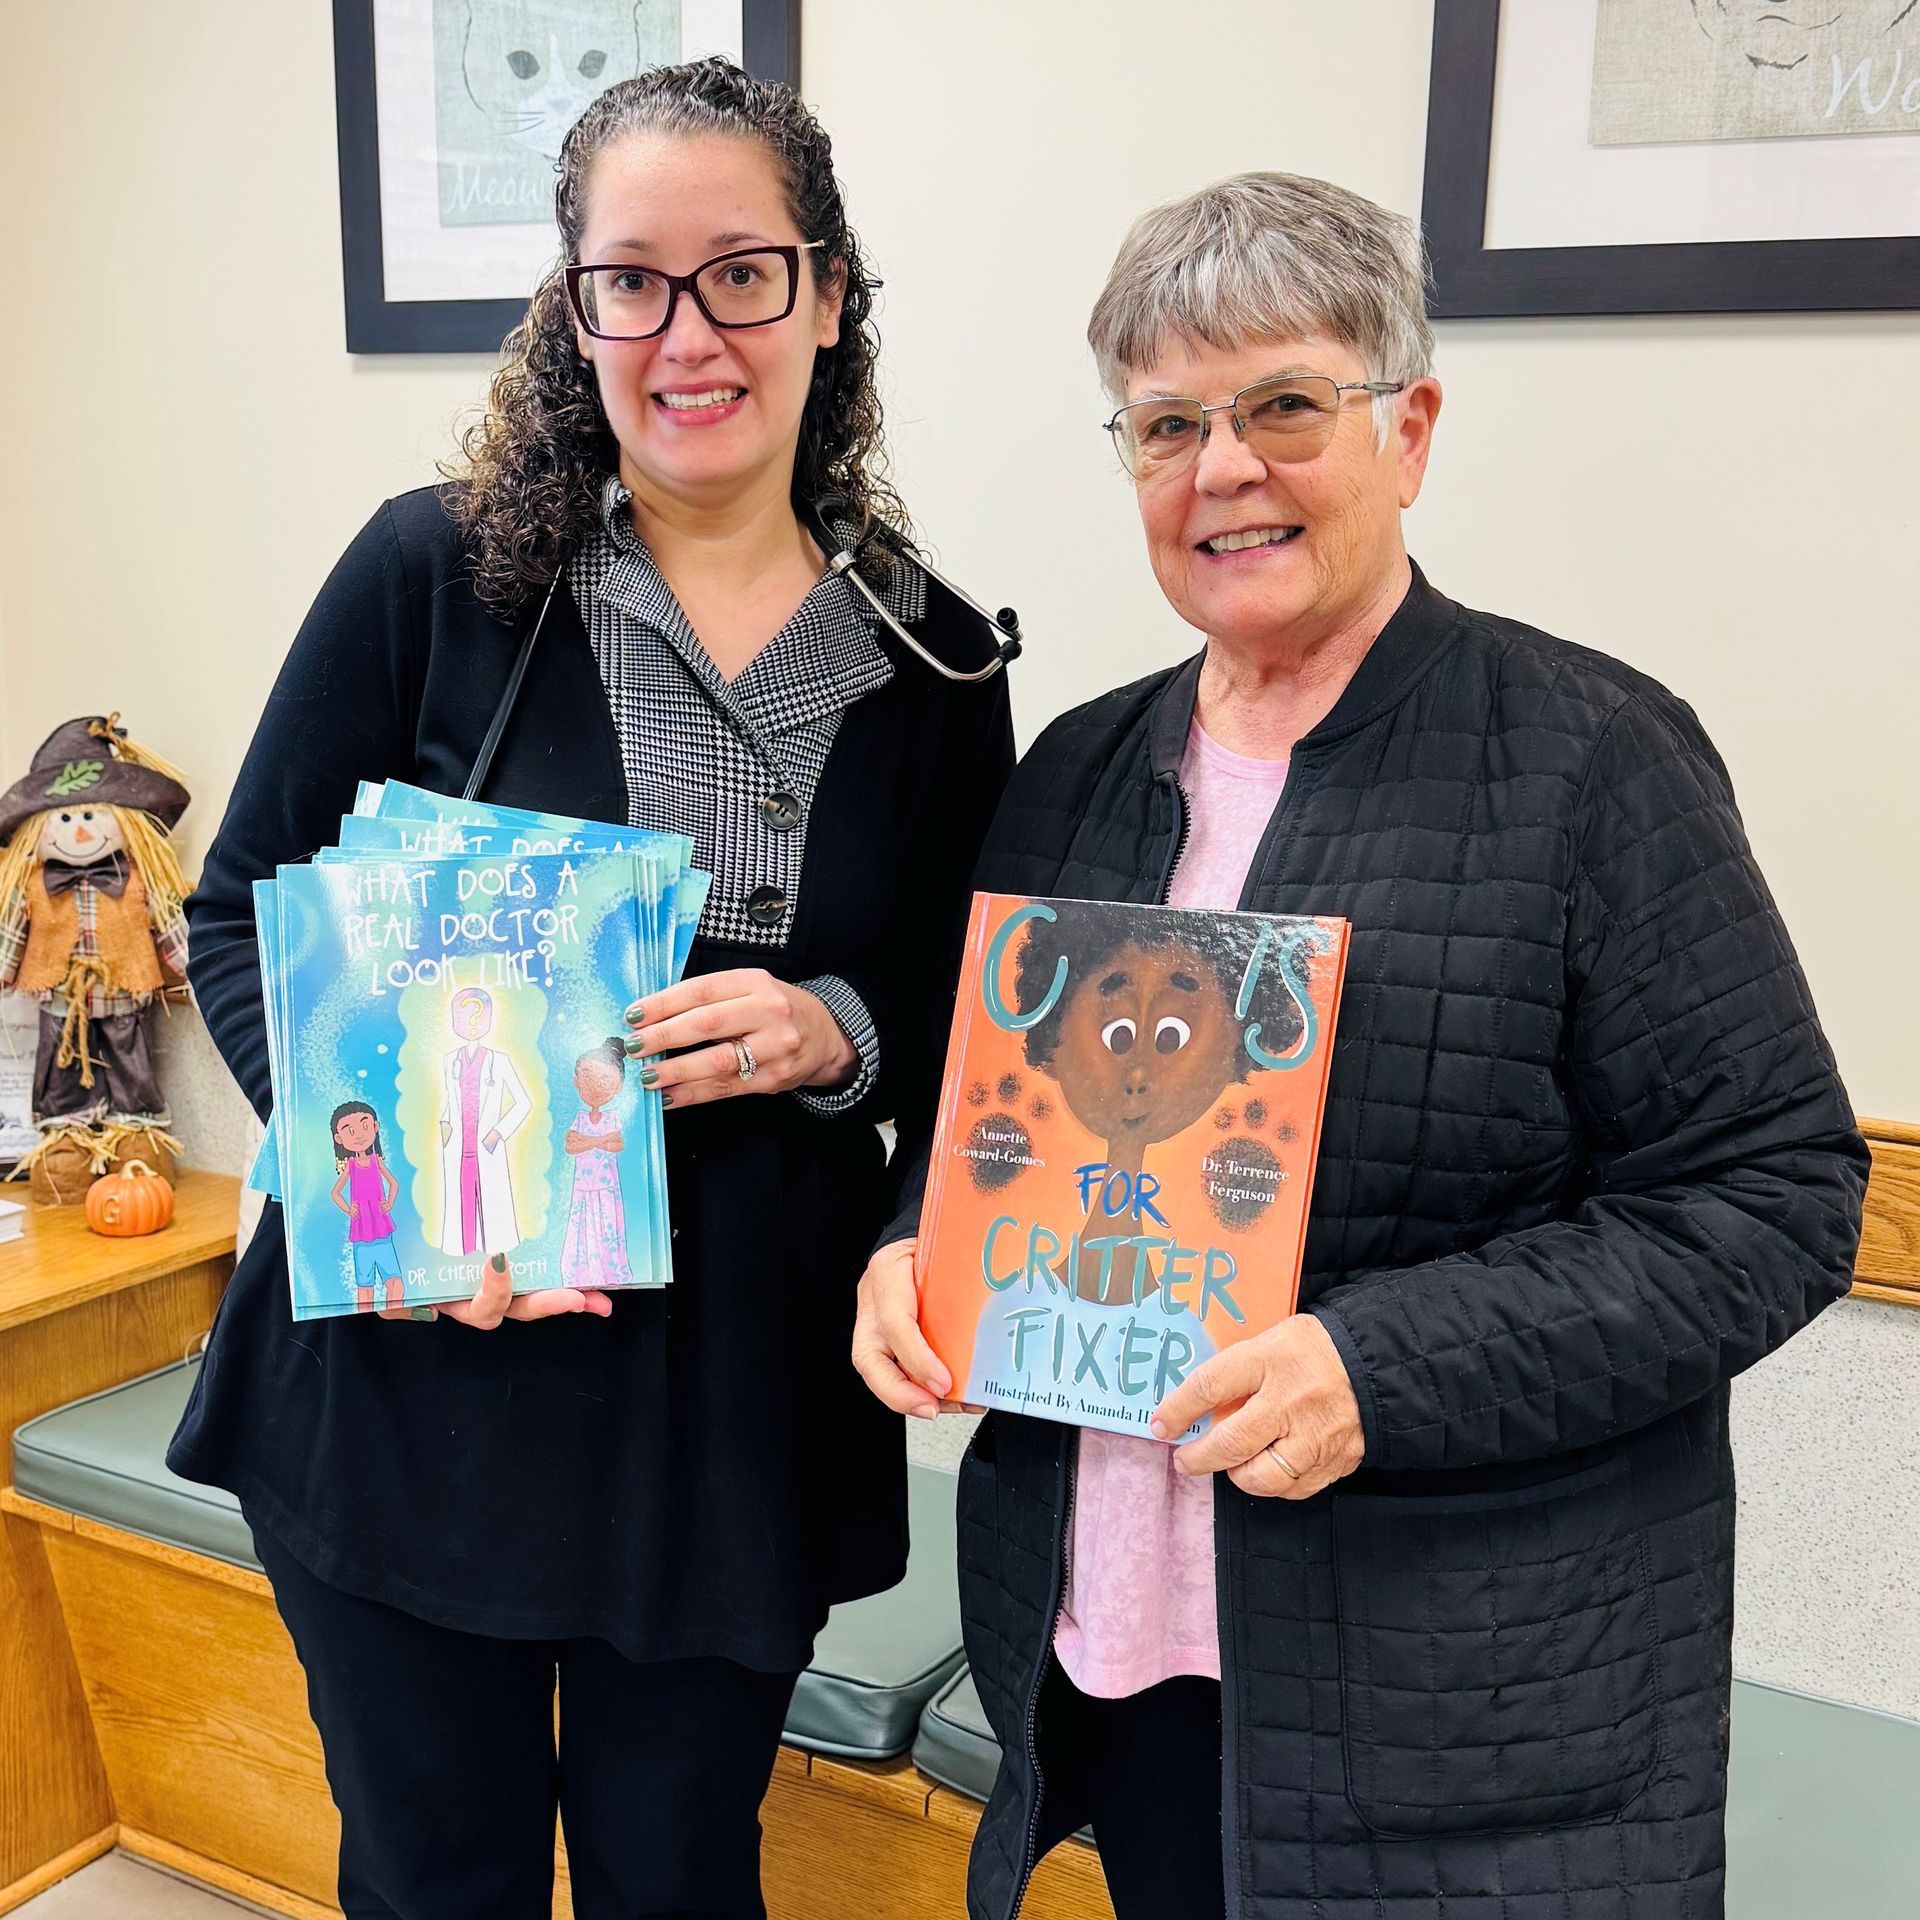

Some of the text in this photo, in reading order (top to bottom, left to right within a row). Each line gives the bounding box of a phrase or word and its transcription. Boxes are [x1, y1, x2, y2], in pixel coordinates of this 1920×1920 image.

[442, 162, 547, 214] Meow
[343, 860, 578, 908] WHAT DOES A
[343, 904, 581, 959] REAL DOCTOR
[371, 940, 556, 996] LOOK LIKE?
[982, 903, 1330, 1071] C IS
[953, 1143, 1047, 1168] Coward-Gomes
[977, 1126, 1028, 1145] Annette
[1201, 1156, 1290, 1181] Dr. Terrence
[1208, 1180, 1276, 1204] Ferguson
[102, 1194, 121, 1225] G
[1072, 1162, 1172, 1228] FOR
[408, 1267, 430, 1287] DR.
[982, 1215, 1247, 1325] CRITTER
[1002, 1305, 1196, 1406] FIXER
[984, 1379, 1052, 1406] Illustrated
[1055, 1393, 1073, 1414] By
[1075, 1398, 1133, 1421] Amanda
